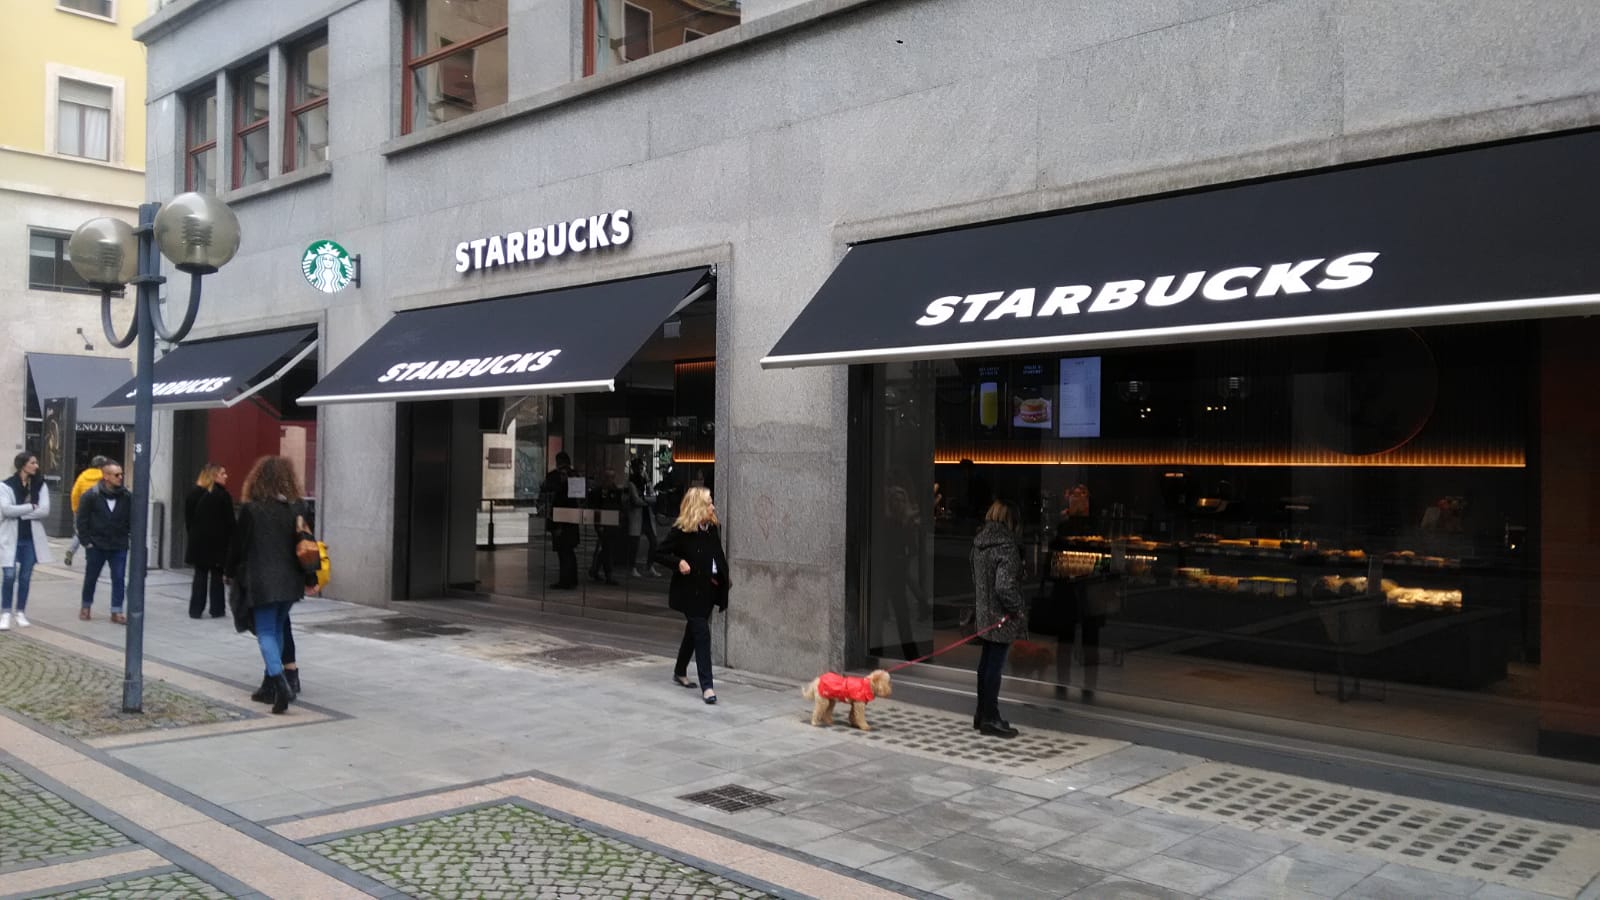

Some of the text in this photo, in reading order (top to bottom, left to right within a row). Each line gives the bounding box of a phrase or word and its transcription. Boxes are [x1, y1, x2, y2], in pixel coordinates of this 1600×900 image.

[455, 209, 631, 273] STARBUCKS
[916, 251, 1381, 327] STARBUCKS
[377, 349, 562, 383] STARBUCKS
[125, 376, 232, 398] ARBUCKS
[75, 423, 126, 433] ENOTECA
